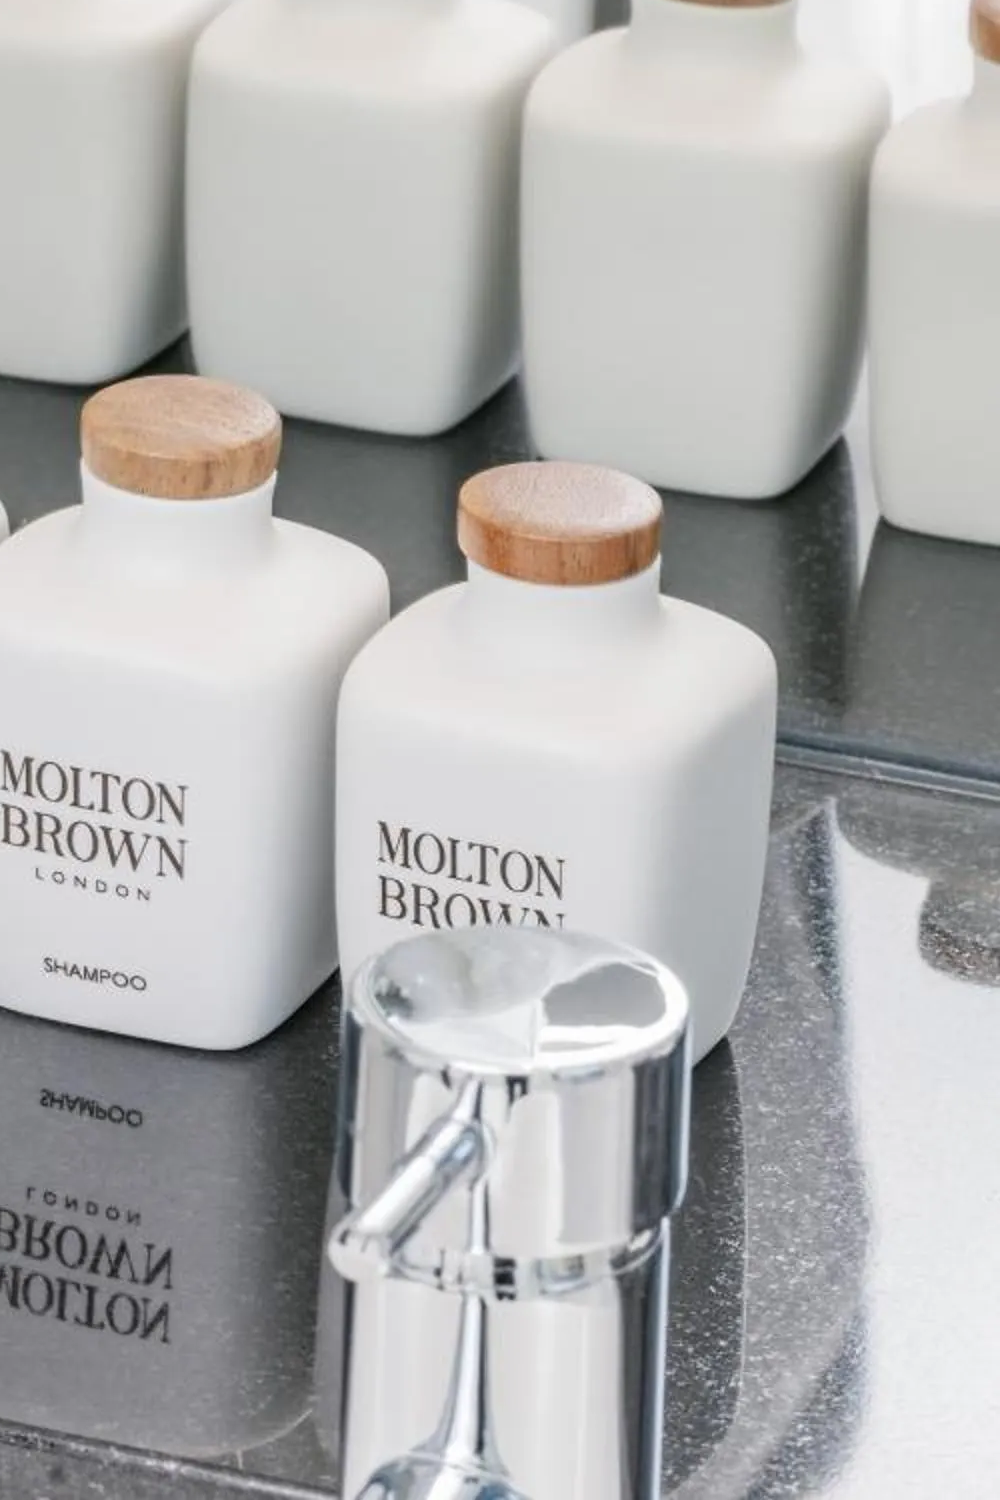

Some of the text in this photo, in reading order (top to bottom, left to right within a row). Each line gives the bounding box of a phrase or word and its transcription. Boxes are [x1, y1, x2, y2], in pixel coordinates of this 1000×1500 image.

[0, 750, 188, 826] MOLTON
[0, 803, 187, 881] BROWN
[377, 821, 565, 900] MOLTON
[36, 867, 151, 901] LONDON
[43, 957, 147, 992] SHAMPOO
